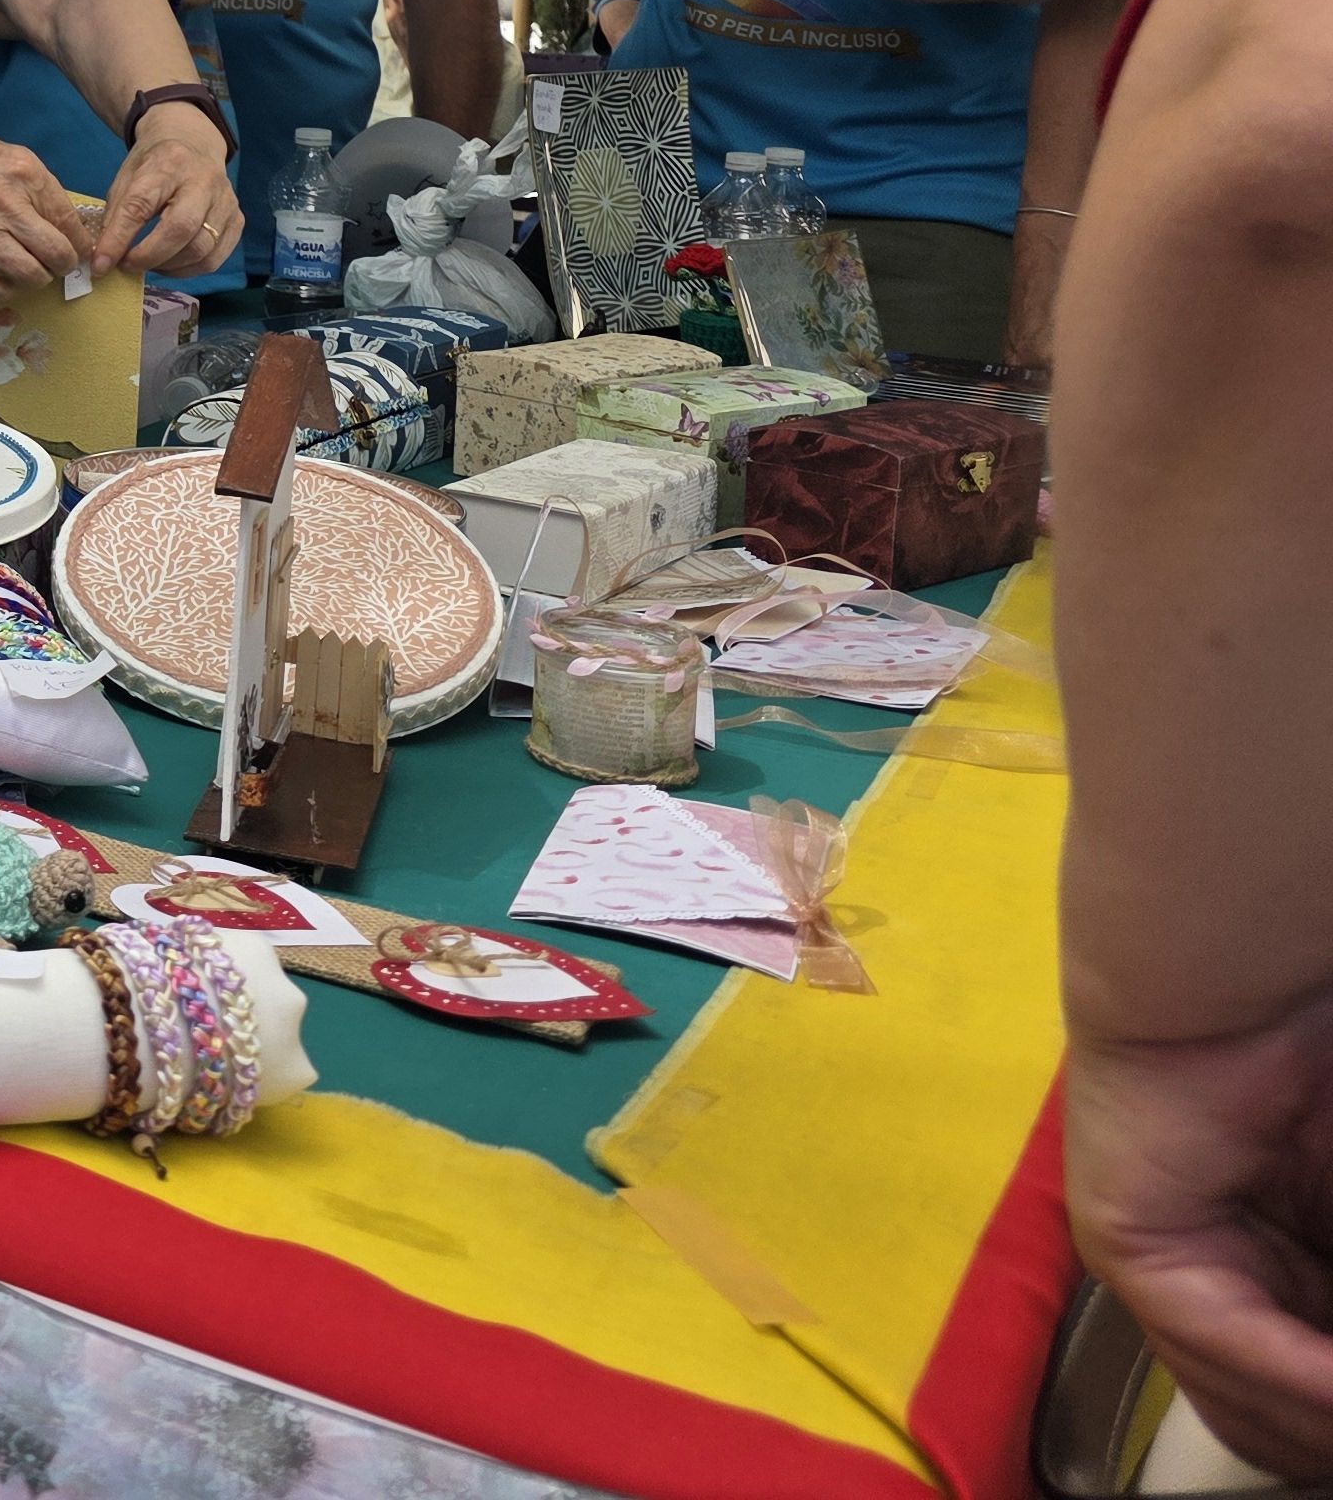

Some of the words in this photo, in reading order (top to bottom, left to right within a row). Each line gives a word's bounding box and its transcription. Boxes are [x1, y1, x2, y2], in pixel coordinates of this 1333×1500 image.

[687, 8, 719, 29] NTS
[721, 18, 764, 42] PER
[768, 27, 796, 44] LA
[801, 29, 901, 49] INCLUSIÓ
[293, 242, 325, 254] AGUA
[283, 267, 332, 279] FUENCISLA
